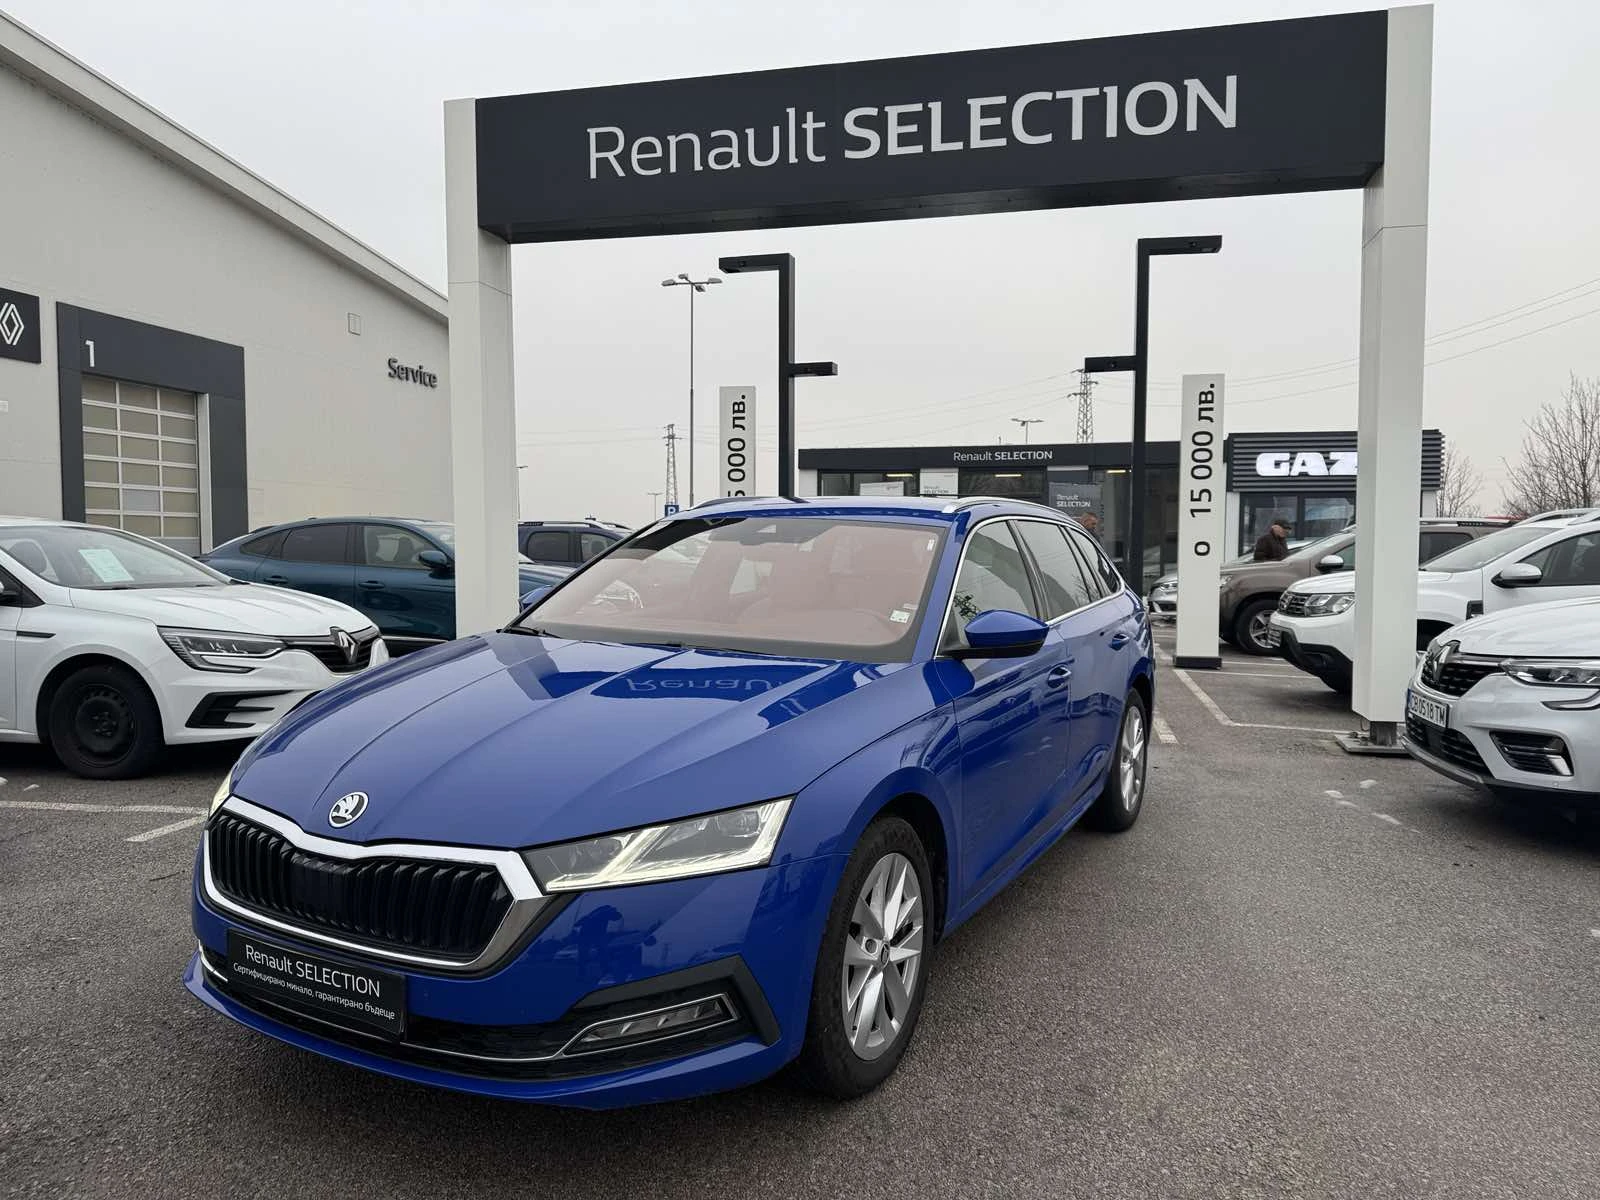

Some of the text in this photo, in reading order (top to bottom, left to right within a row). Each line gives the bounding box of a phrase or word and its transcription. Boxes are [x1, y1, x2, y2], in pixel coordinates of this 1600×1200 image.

[587, 75, 1238, 180] Renault SELECTION
[86, 339, 95, 368] 1
[388, 358, 438, 388] Service
[732, 394, 746, 431] лв.
[1197, 383, 1215, 423] лв.
[727, 437, 746, 483] 000
[953, 450, 1053, 461] Renault SELECTION
[1190, 430, 1214, 480] 000
[1255, 452, 1358, 476] GAZ
[1190, 488, 1212, 518] 15
[245, 943, 381, 999] Renault SELECTION
[233, 962, 395, 1020] Сертифицирано минало, гарантирано бъдеще
